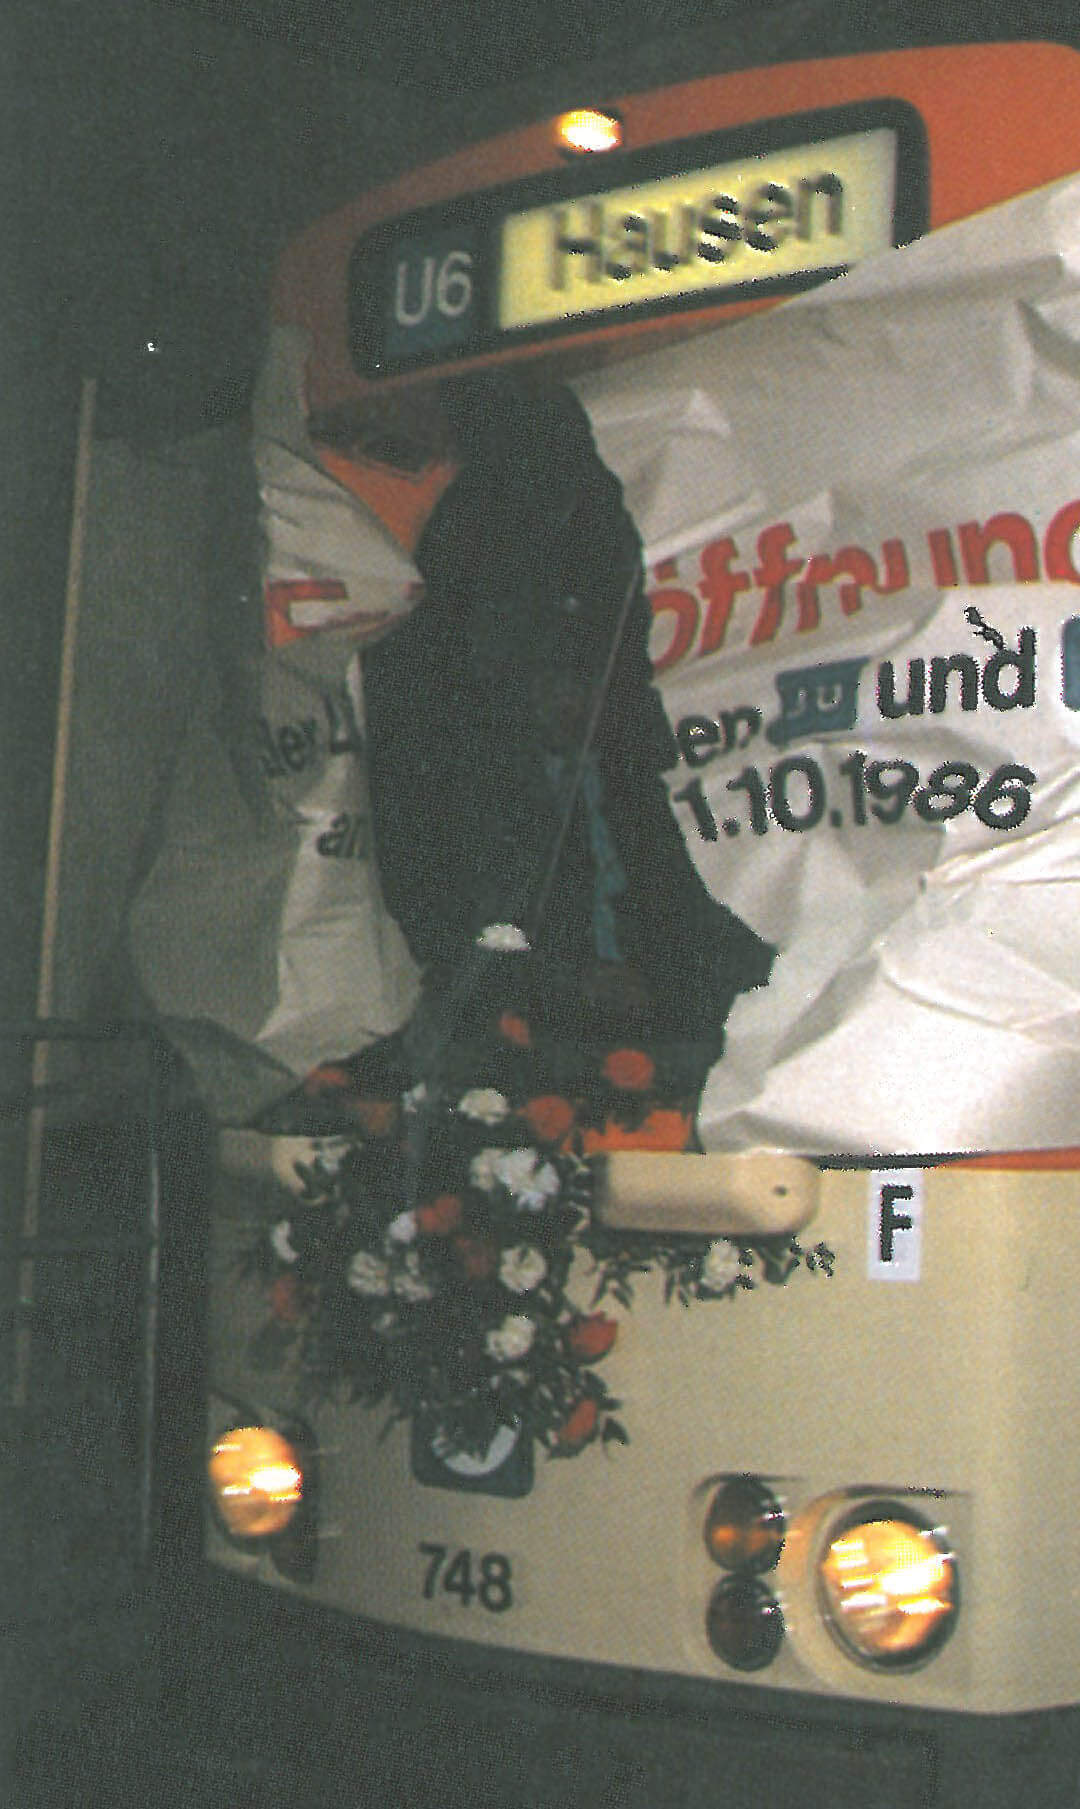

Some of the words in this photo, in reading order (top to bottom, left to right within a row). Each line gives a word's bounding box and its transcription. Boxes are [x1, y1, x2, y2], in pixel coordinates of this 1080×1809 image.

[393, 249, 474, 327] U6
[551, 170, 844, 290] Hausen
[876, 624, 1037, 721] und
[879, 1183, 914, 1263] F
[418, 1541, 514, 1614] 748
